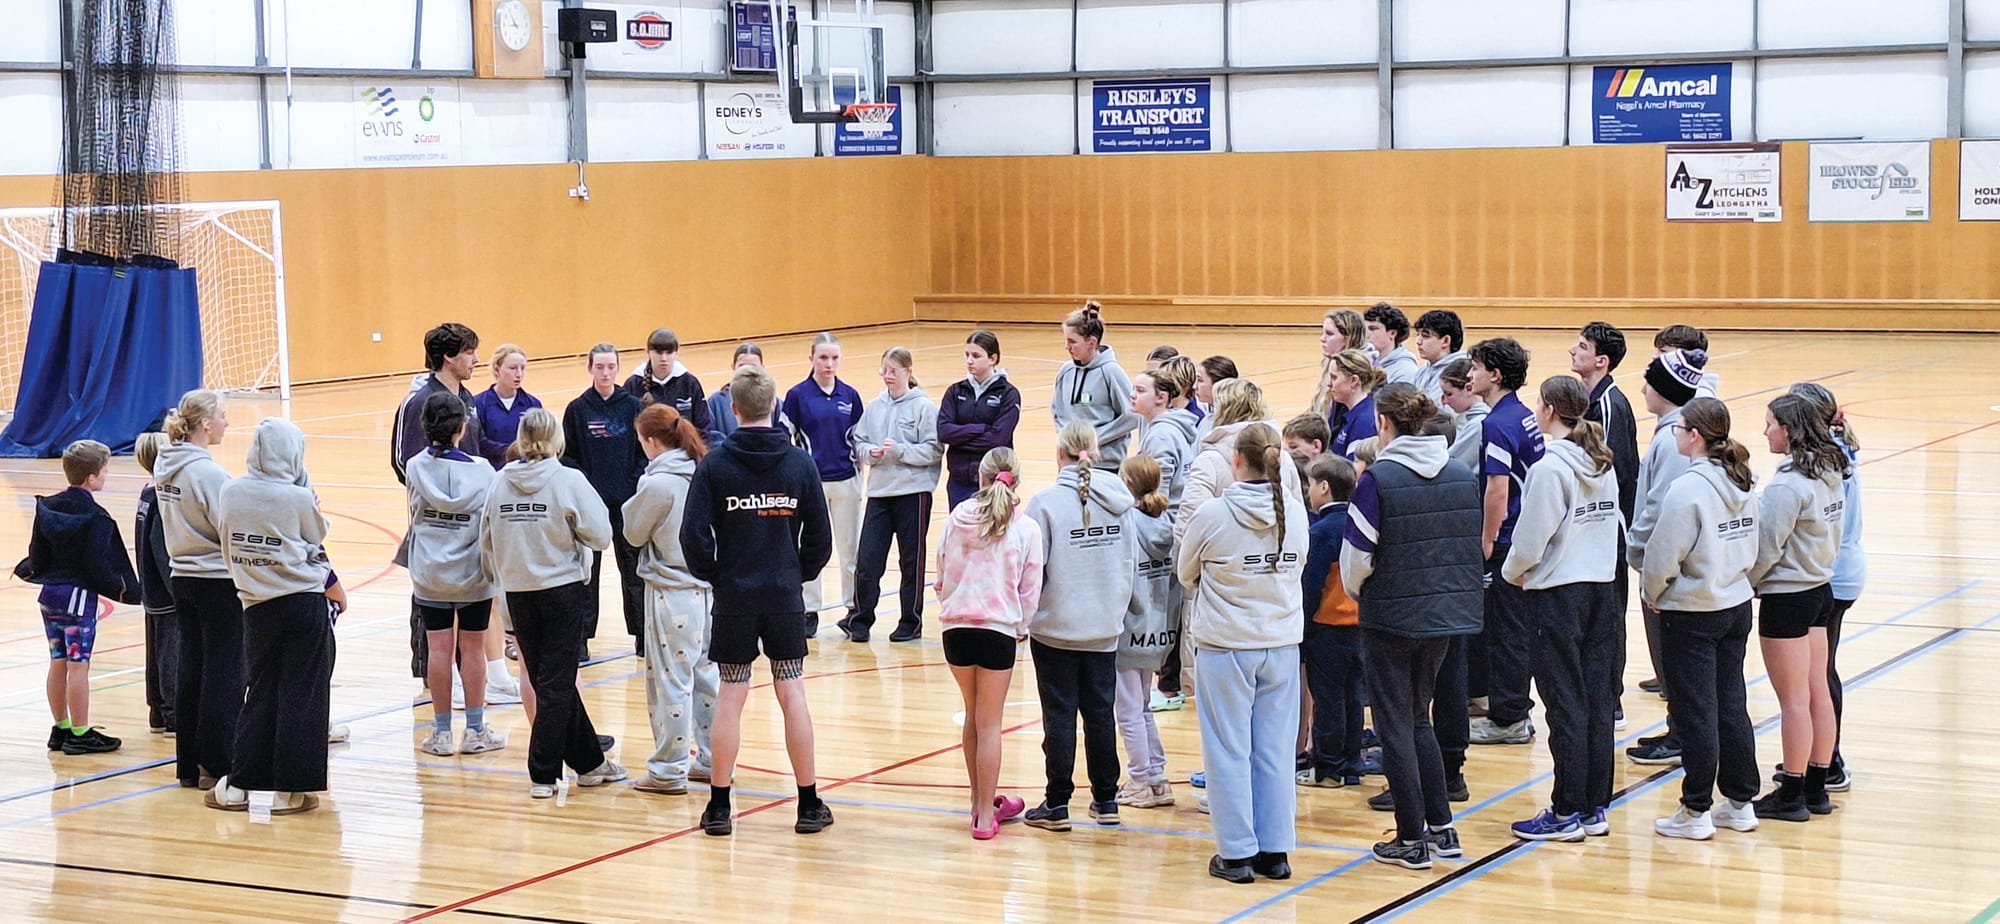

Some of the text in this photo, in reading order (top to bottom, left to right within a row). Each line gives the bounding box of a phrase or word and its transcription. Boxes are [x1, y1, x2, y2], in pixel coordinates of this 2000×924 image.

[1640, 74, 1718, 97] Amcal
[1107, 88, 1197, 106] RISELEY'S
[1644, 101, 1668, 110] Amcal
[1669, 101, 1706, 110] Pharmacy
[1099, 108, 1205, 126] TRANSPORT
[1820, 165, 1878, 177] BROWNS
[1713, 187, 1768, 198] KITCHENS
[1716, 200, 1768, 208] LEONGATHA
[1974, 197, 2000, 206] CON
[500, 503, 547, 512] SGB
[424, 509, 471, 521] SGB
[1070, 525, 1120, 539] SGB
[231, 532, 282, 546] SGB
[1243, 553, 1297, 564] SGB
